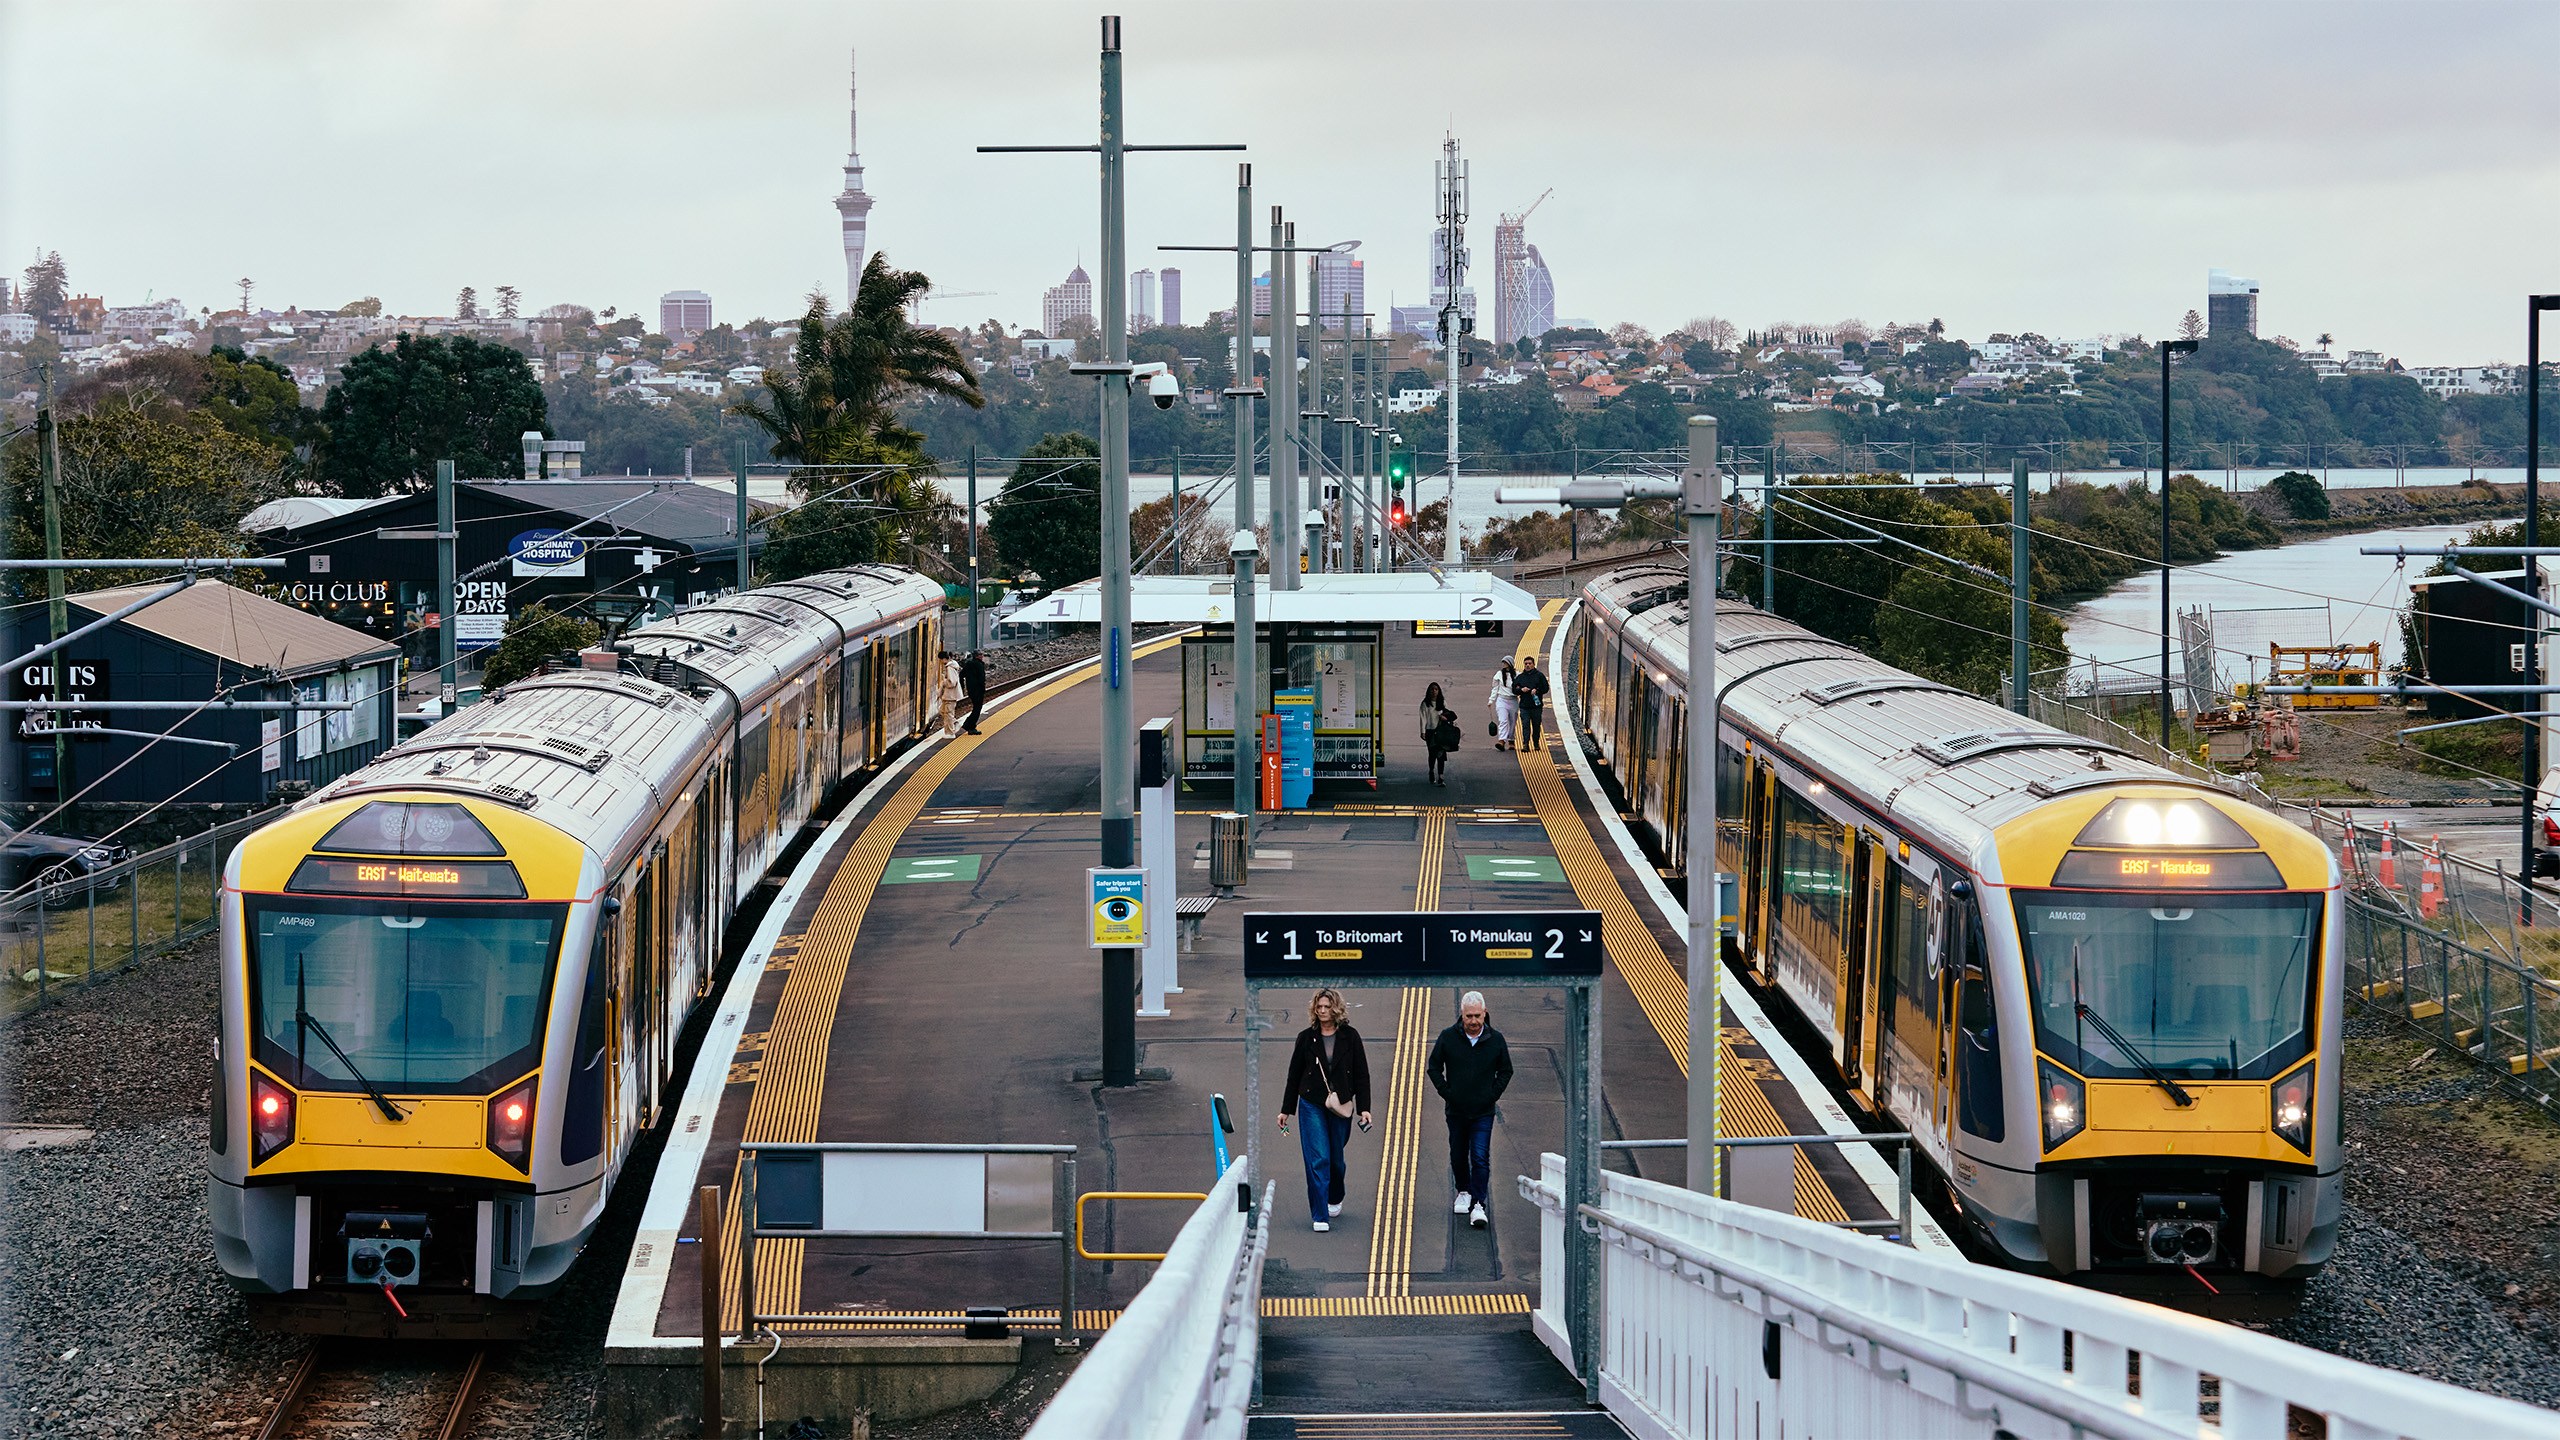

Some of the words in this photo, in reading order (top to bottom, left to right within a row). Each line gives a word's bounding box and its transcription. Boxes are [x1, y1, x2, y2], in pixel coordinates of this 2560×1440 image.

[523, 549, 574, 558] HOSPITAL
[330, 584, 387, 601] CLUB
[456, 582, 506, 599] OPEN
[466, 600, 506, 613] DAYS
[1048, 599, 1070, 616] 1
[1471, 598, 1493, 615] 2
[1211, 663, 1218, 676] 1
[1325, 662, 1334, 675] 2
[358, 866, 386, 880] EAST
[399, 867, 459, 883] Waitemata
[2122, 860, 2150, 874] EAST
[2160, 860, 2210, 874] Manukau
[279, 917, 315, 927] AMP469
[2049, 911, 2086, 920] AMA1020
[1283, 930, 1302, 960] 1
[1316, 931, 1333, 943] To
[1336, 930, 1403, 943] Britomart
[1450, 930, 1467, 942] To
[1470, 929, 1532, 942] Manukau
[1544, 929, 1564, 958] 2
